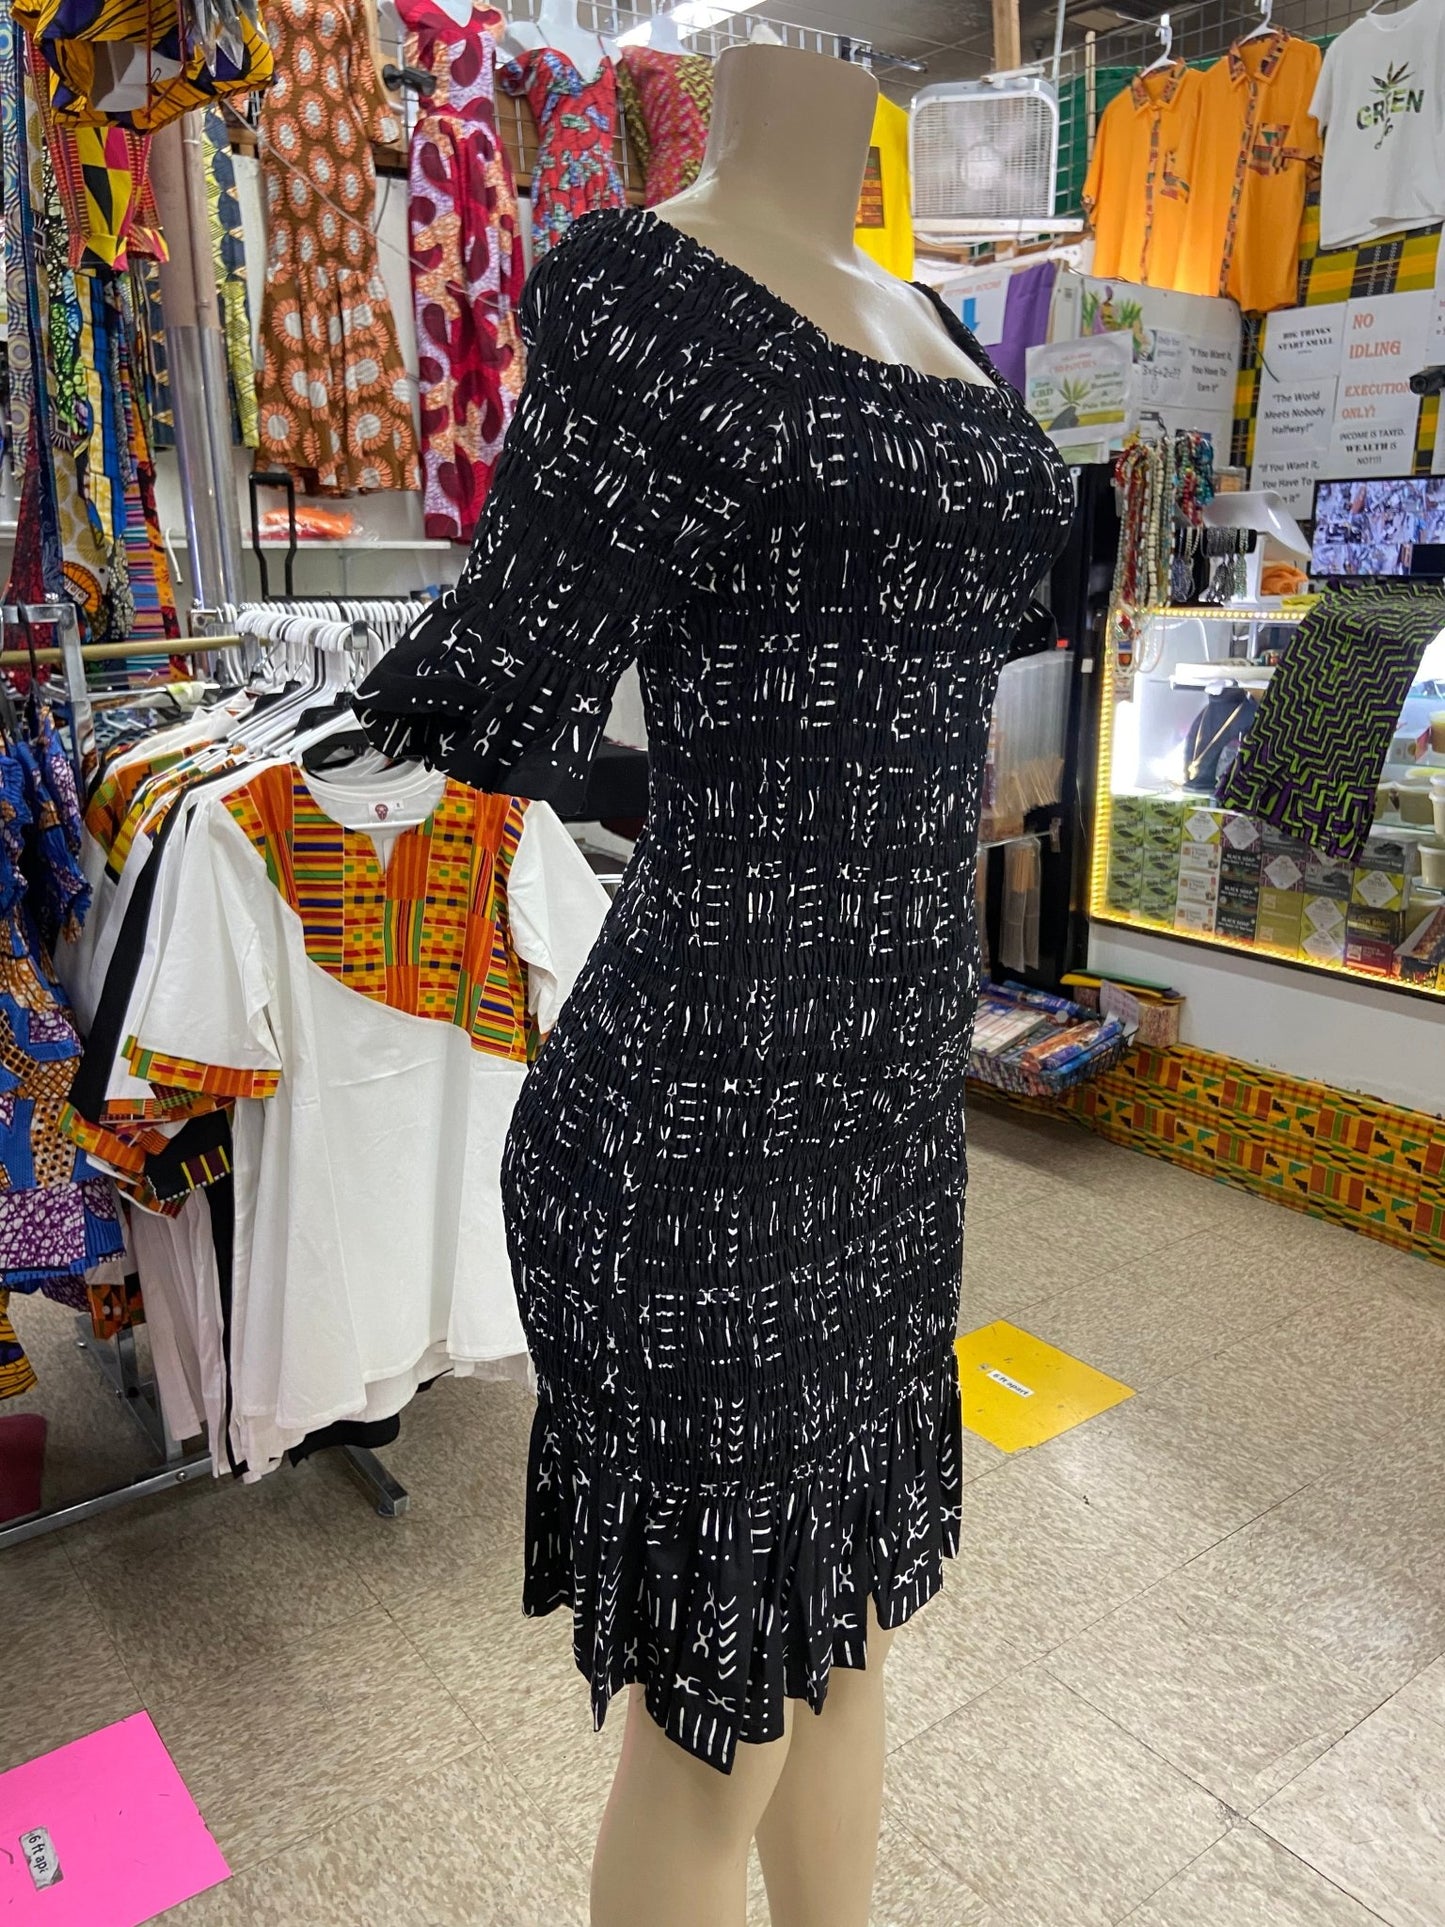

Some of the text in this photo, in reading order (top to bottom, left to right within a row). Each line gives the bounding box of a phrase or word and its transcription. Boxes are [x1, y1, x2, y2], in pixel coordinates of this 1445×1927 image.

[1353, 312, 1374, 330] NO
[1349, 340, 1402, 359] IDLING
[1192, 365, 1204, 375] You
[1204, 366, 1218, 377] Have
[1344, 382, 1411, 397] EXECUTION
[1294, 390, 1320, 402] World
[1264, 407, 1326, 420] Meets Nobody
[1339, 430, 1369, 441] INCOME
[1346, 442, 1388, 452] WEALTH
[1269, 463, 1284, 472] You
[1286, 461, 1309, 471] Want
[1262, 476, 1312, 489] You Have To
[1007, 1382, 1029, 1395] apart
[29, 1835, 41, 1844] 6
[31, 1843, 45, 1855] ft
